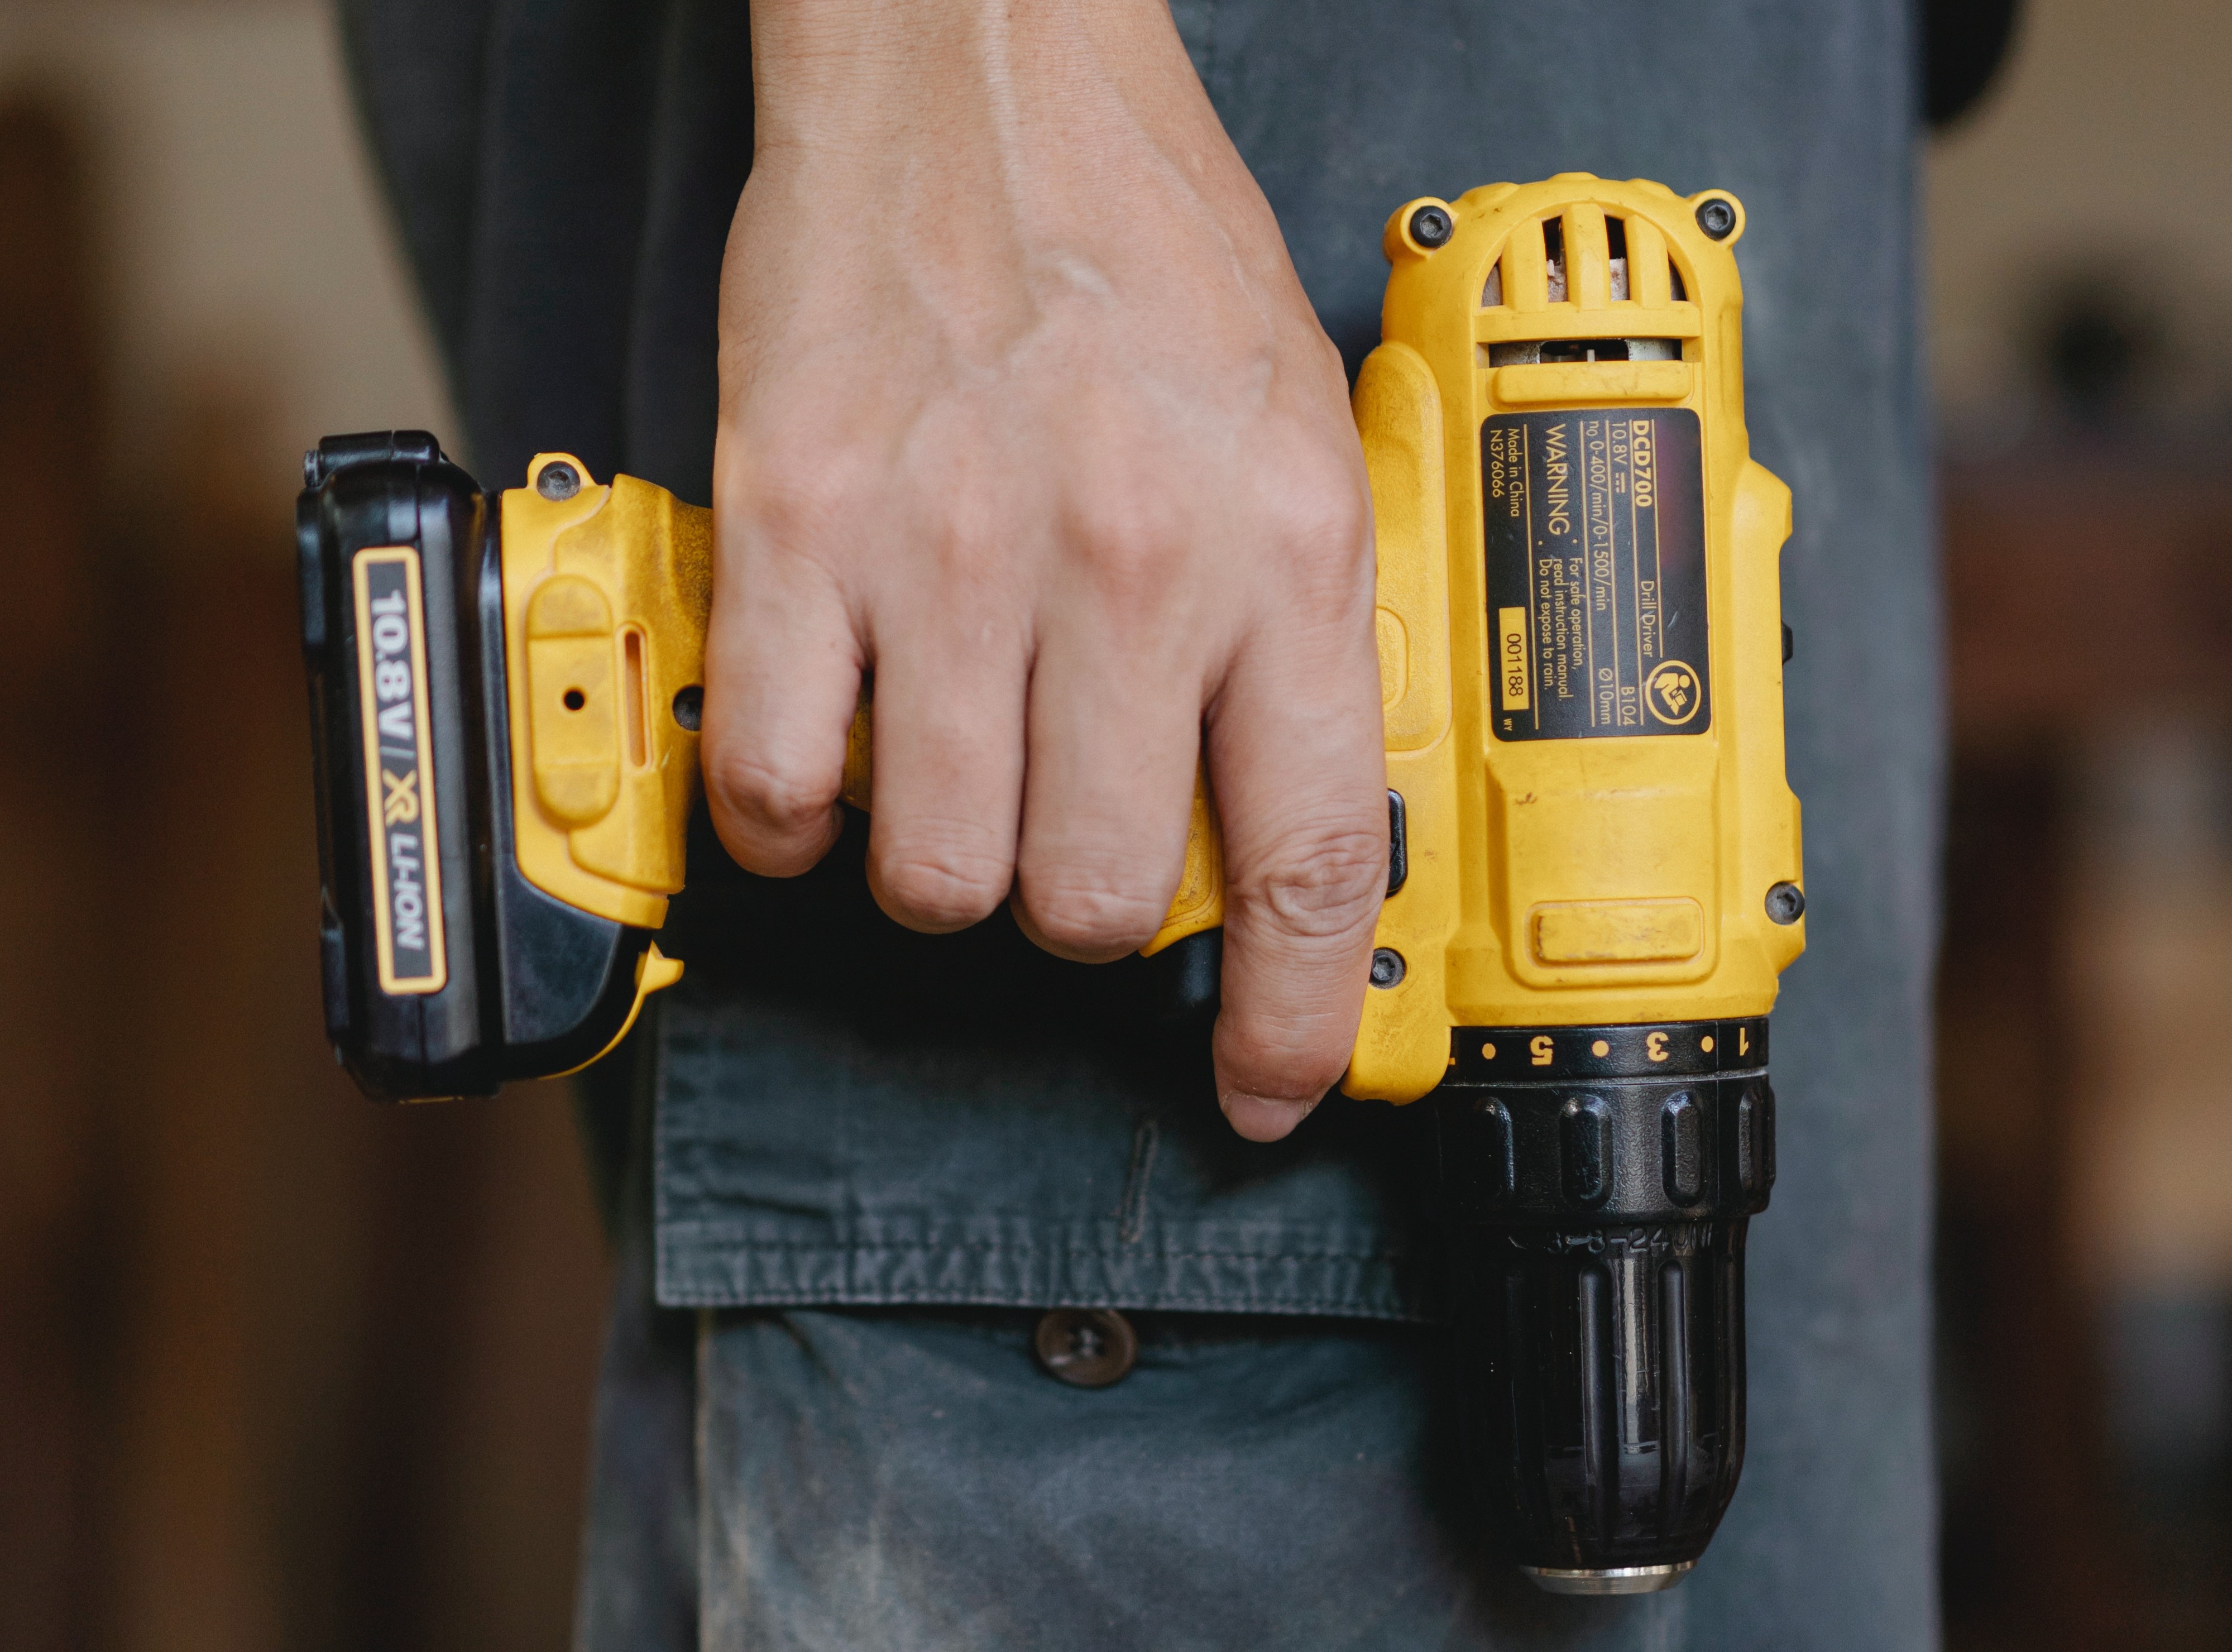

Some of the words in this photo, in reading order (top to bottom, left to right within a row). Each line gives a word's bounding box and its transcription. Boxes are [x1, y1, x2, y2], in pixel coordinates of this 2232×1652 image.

[1507, 428, 1521, 463] Made
[1612, 421, 1627, 465] 10.8V
[1491, 430, 1504, 497] N376066
[1509, 467, 1522, 478] in
[1545, 424, 1569, 535] WARNING
[1632, 420, 1653, 507] DCD700
[1510, 481, 1524, 517] China
[1589, 441, 1610, 611] 0-400/min/0-1500/min
[1539, 559, 1551, 580] Do
[1553, 559, 1565, 586] read
[1569, 558, 1582, 578] For
[1540, 584, 1552, 598] not
[1570, 582, 1583, 605] safe
[1641, 581, 1654, 610] Drill
[1538, 602, 1553, 644] expose
[1555, 591, 1568, 650] instruction
[1642, 614, 1656, 658] Driver
[1543, 648, 1554, 658] to
[1569, 609, 1584, 670] operation,
[371, 590, 414, 740] 10.8V
[1507, 633, 1524, 697] 001188
[1544, 662, 1555, 689] rain.
[1556, 654, 1569, 701] manual.
[1503, 718, 1512, 731] WY
[1621, 687, 1636, 726] B104
[381, 769, 420, 827] XR
[390, 832, 424, 951] LI-ION
[1530, 1035, 1554, 1065] 5
[1646, 1032, 1669, 1062] 3
[1739, 1027, 1749, 1056] 1
